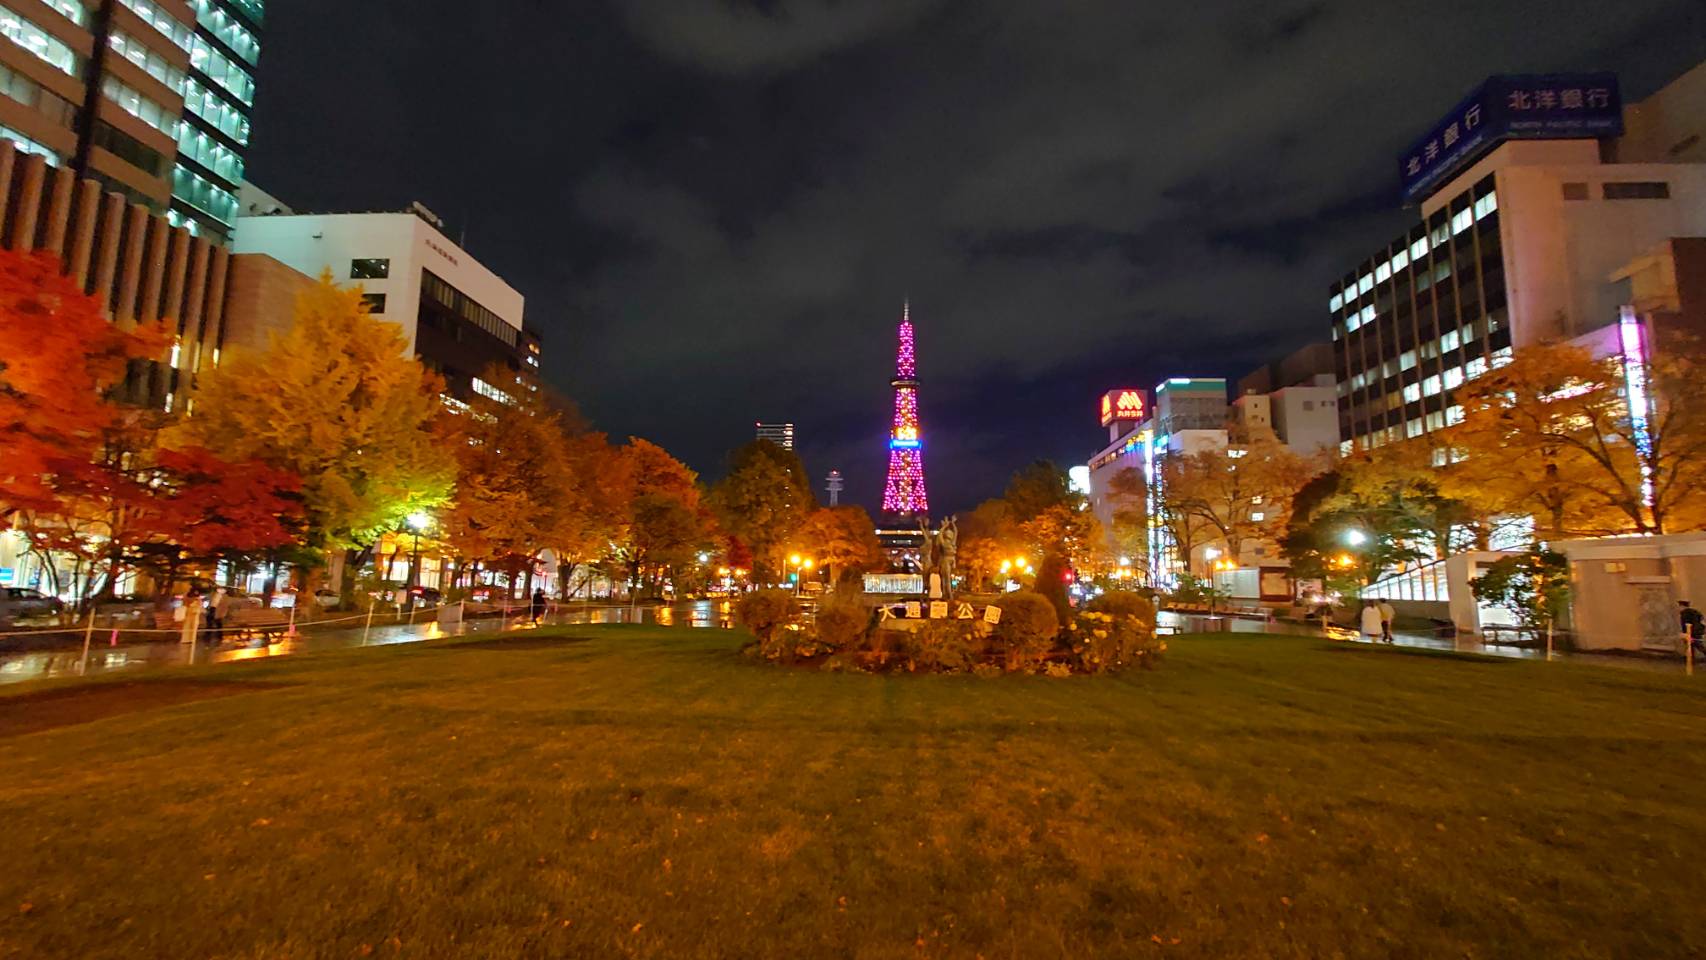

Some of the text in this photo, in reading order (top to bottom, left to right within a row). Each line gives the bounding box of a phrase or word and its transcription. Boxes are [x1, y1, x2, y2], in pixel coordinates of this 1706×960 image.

[1508, 88, 1610, 111] 北洋銀行
[1406, 103, 1482, 177] 北洋銀行
